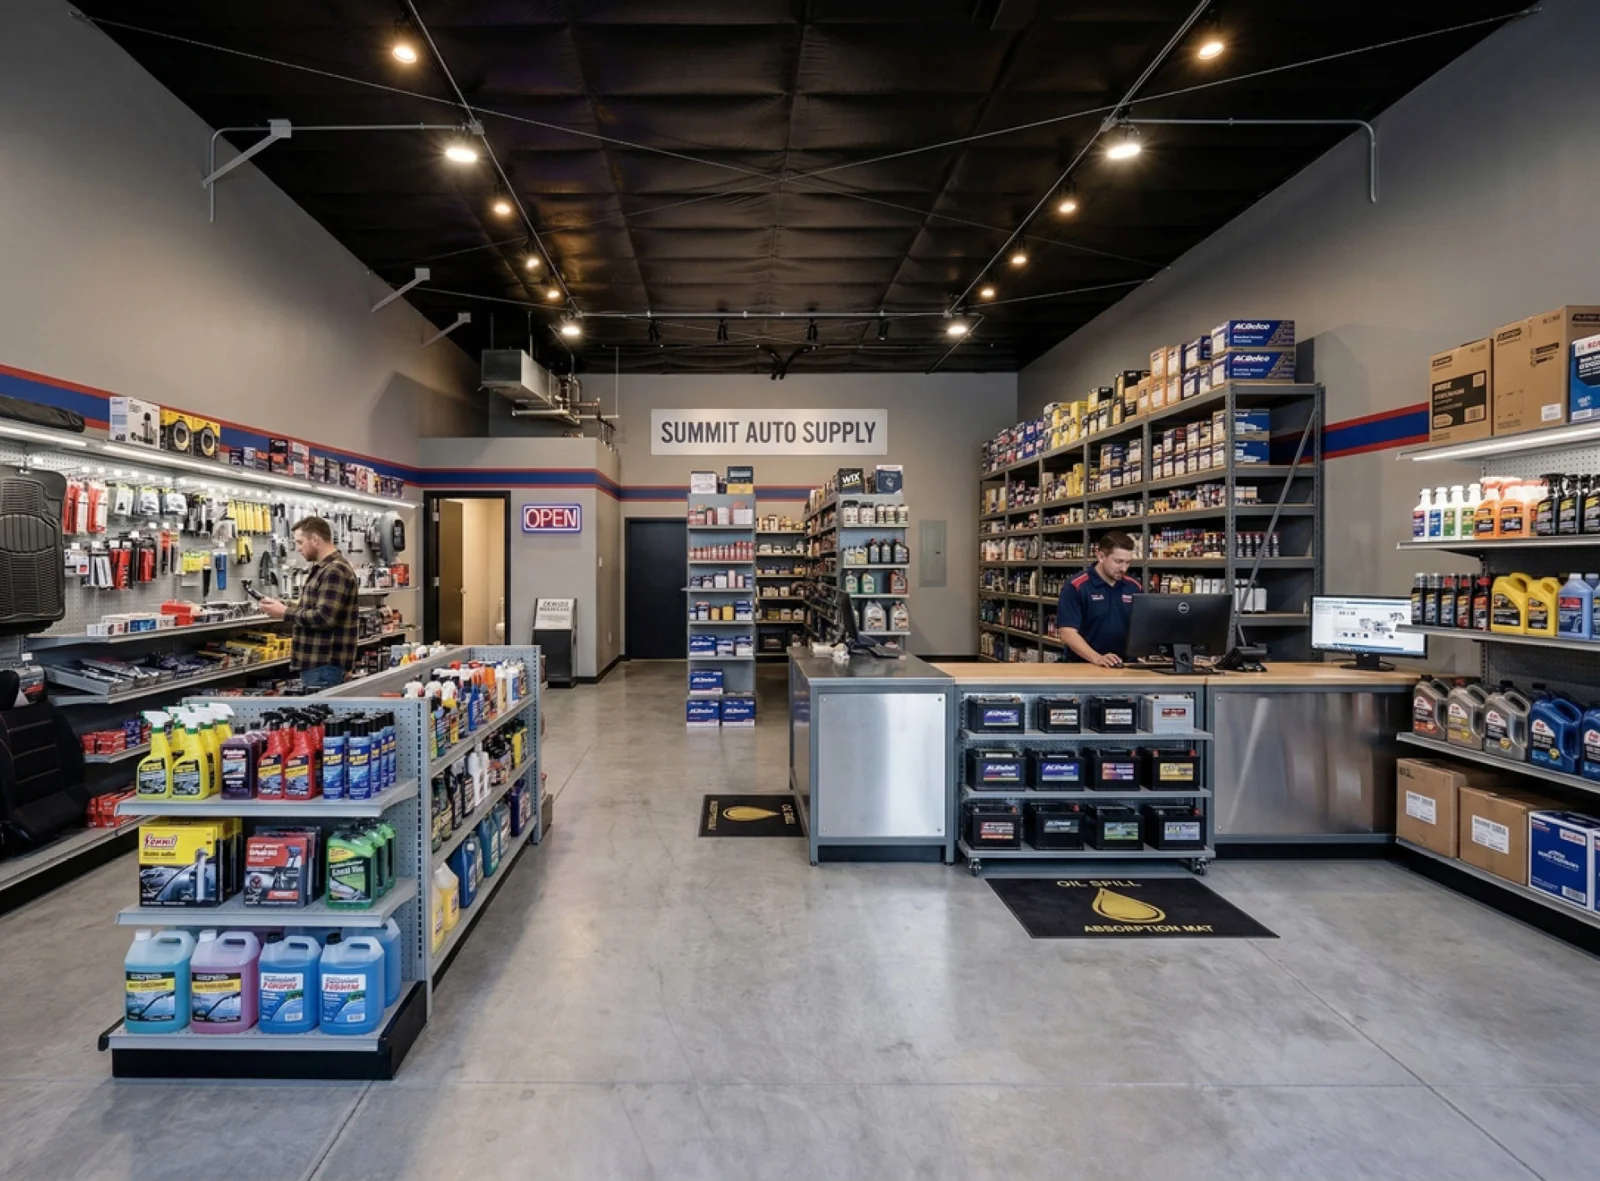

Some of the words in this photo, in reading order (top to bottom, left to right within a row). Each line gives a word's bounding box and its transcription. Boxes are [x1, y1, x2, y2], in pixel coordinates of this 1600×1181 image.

[661, 421, 740, 443] SUMMIT
[745, 421, 797, 443] AUTO
[802, 421, 876, 443] SUPPLY
[526, 508, 577, 528] OPEN
[1056, 880, 1088, 888] OIL
[1084, 925, 1181, 933] ABSORPTION
